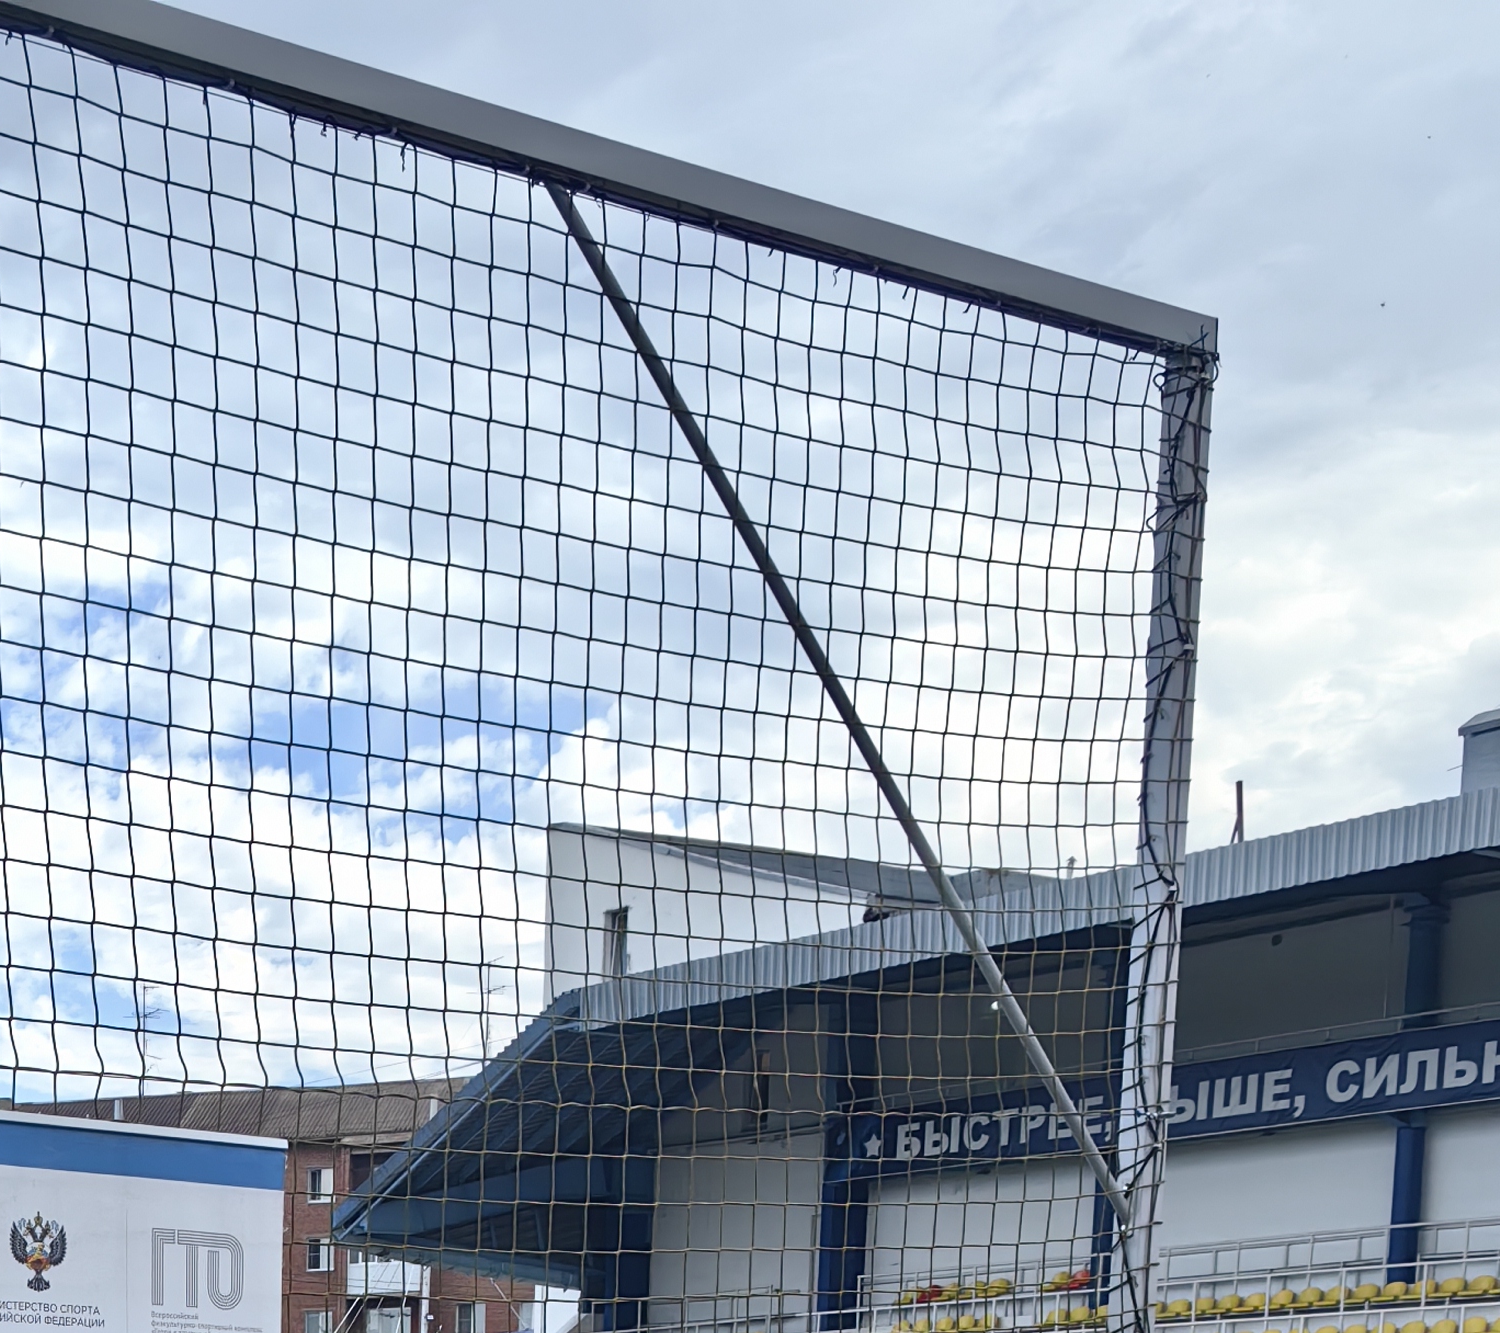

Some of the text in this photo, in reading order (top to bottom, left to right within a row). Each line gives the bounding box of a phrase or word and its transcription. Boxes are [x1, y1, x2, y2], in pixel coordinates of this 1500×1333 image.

[1167, 1068, 1306, 1125] ЫШЕ,
[60, 1304, 101, 1316] СПОРТА
[44, 1316, 105, 1329] ФЕДЕРАЦИИ
